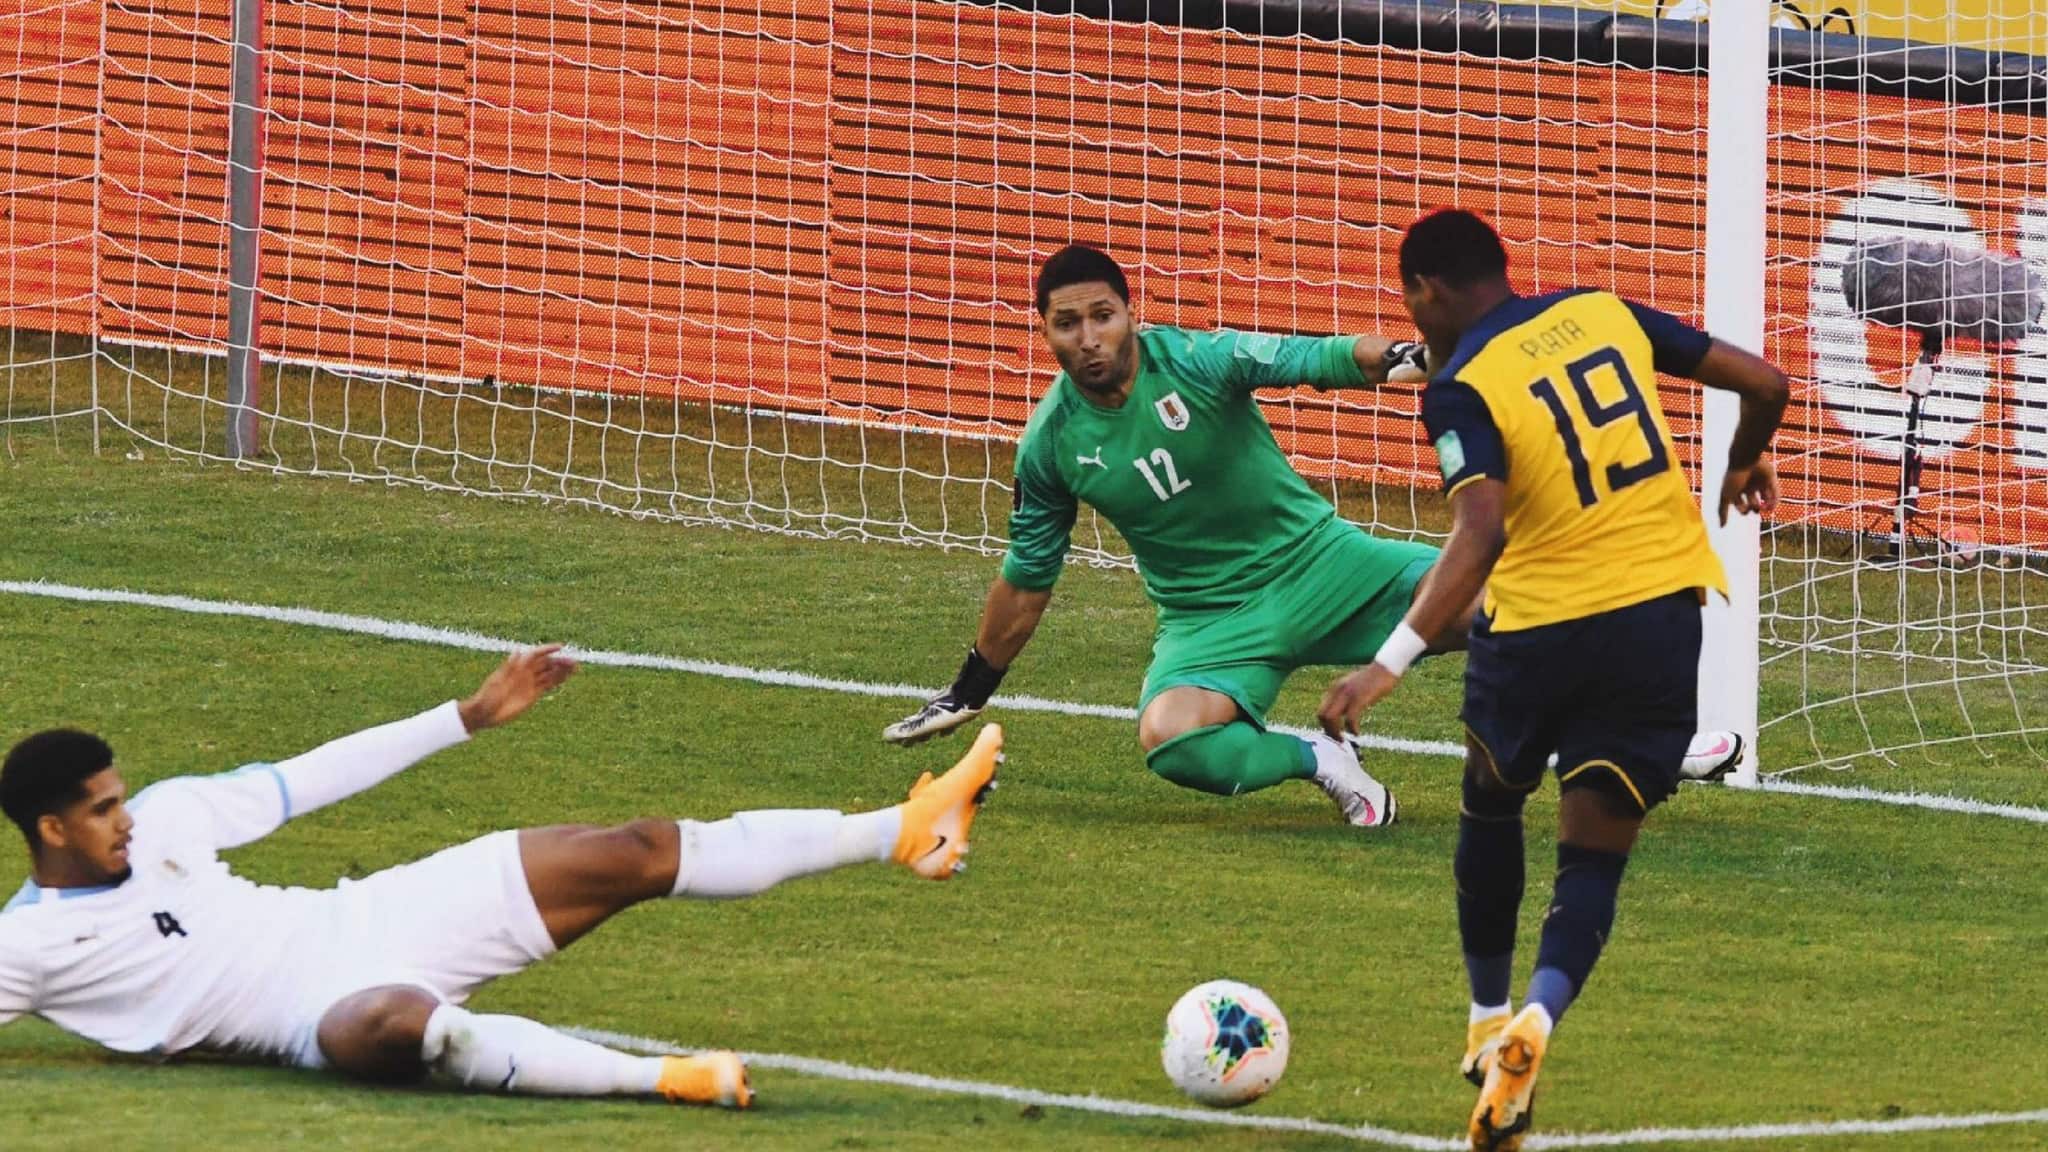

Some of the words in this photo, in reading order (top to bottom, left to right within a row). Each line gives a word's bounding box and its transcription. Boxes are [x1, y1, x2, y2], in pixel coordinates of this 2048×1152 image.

[1520, 318, 1587, 360] PLATA
[1529, 346, 1670, 509] 19
[1133, 447, 1192, 501] 12
[152, 909, 188, 938] 4
